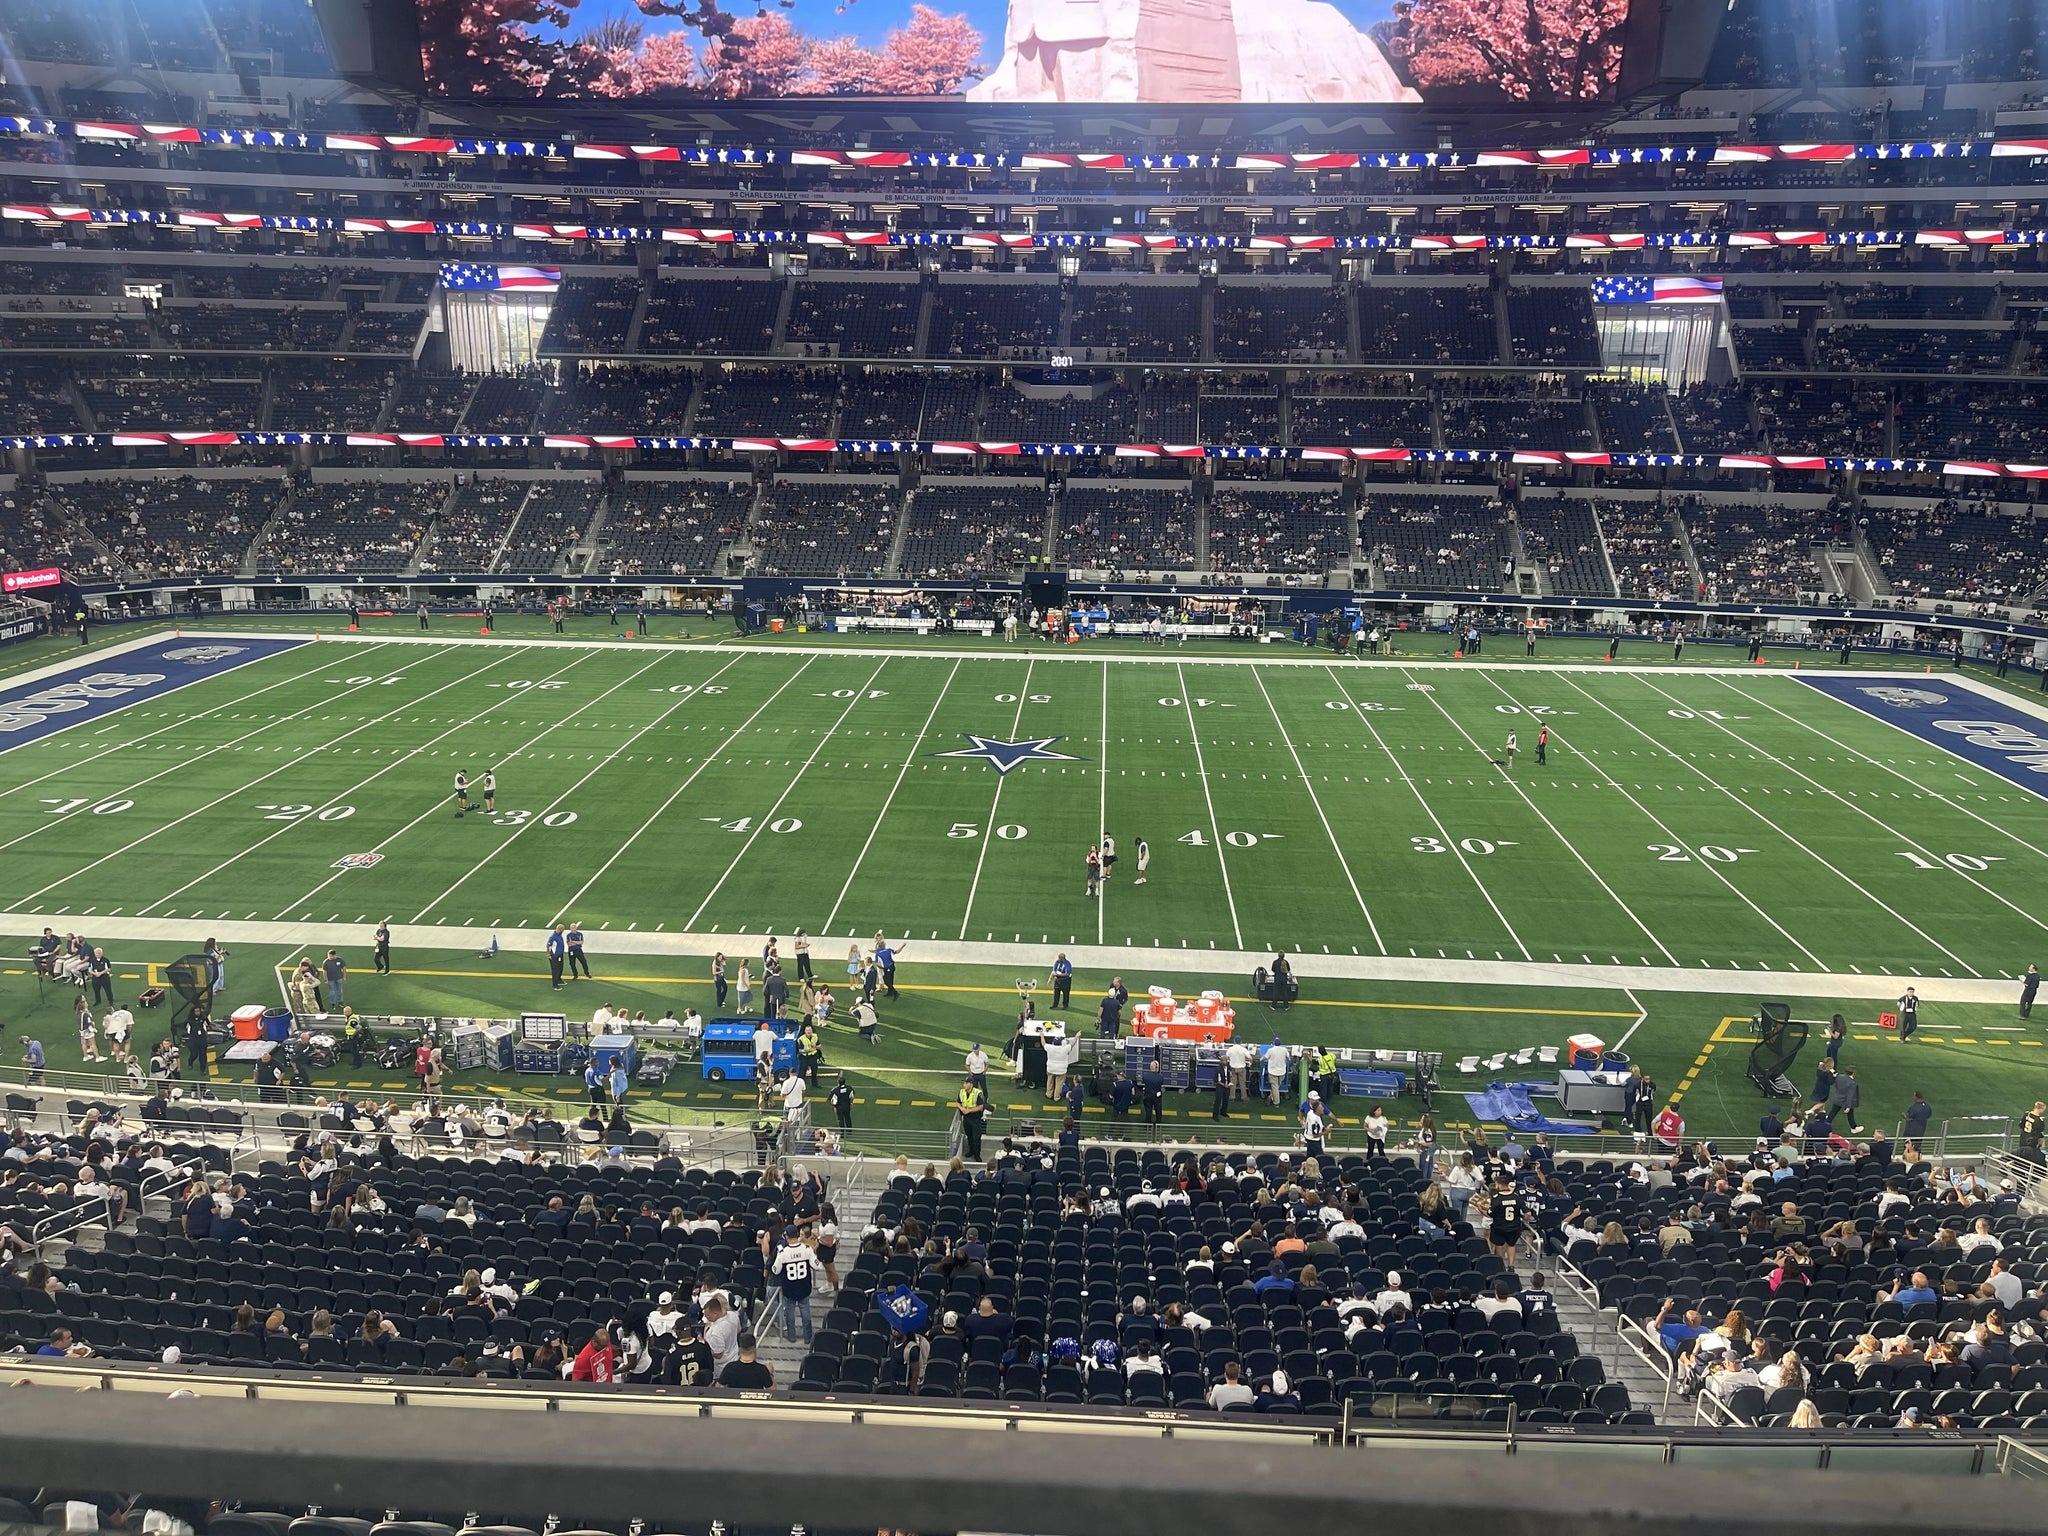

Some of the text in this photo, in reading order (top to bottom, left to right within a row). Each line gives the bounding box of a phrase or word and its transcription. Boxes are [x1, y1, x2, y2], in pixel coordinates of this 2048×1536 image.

[606, 188, 645, 196] WOODSON
[894, 194, 924, 202] MICHAEL
[15, 573, 57, 586] Blockchain
[345, 676, 407, 685] 10
[506, 680, 569, 689] 20
[668, 684, 729, 694] 30
[831, 689, 890, 698] 40
[994, 693, 1052, 703] 50
[1157, 697, 1216, 707] 40
[1324, 701, 1385, 711] 30
[1494, 705, 1558, 715] 20
[1667, 709, 1731, 720] 10
[43, 798, 135, 815] 10
[263, 804, 356, 821] 20
[492, 810, 578, 827] 30
[719, 817, 803, 834] 40
[946, 823, 1028, 840] 50
[1177, 830, 1258, 847] 40
[1410, 836, 1496, 855] 30
[1647, 844, 1738, 862] 20
[1894, 851, 1989, 871] 10
[1163, 1005, 1172, 1015] G
[1202, 1007, 1211, 1016] G
[1883, 1015, 1896, 1027] 20
[1152, 1026, 1169, 1042] G
[1505, 1206, 1514, 1221] 6
[786, 1261, 808, 1281] 88
[679, 1361, 699, 1386] 12
